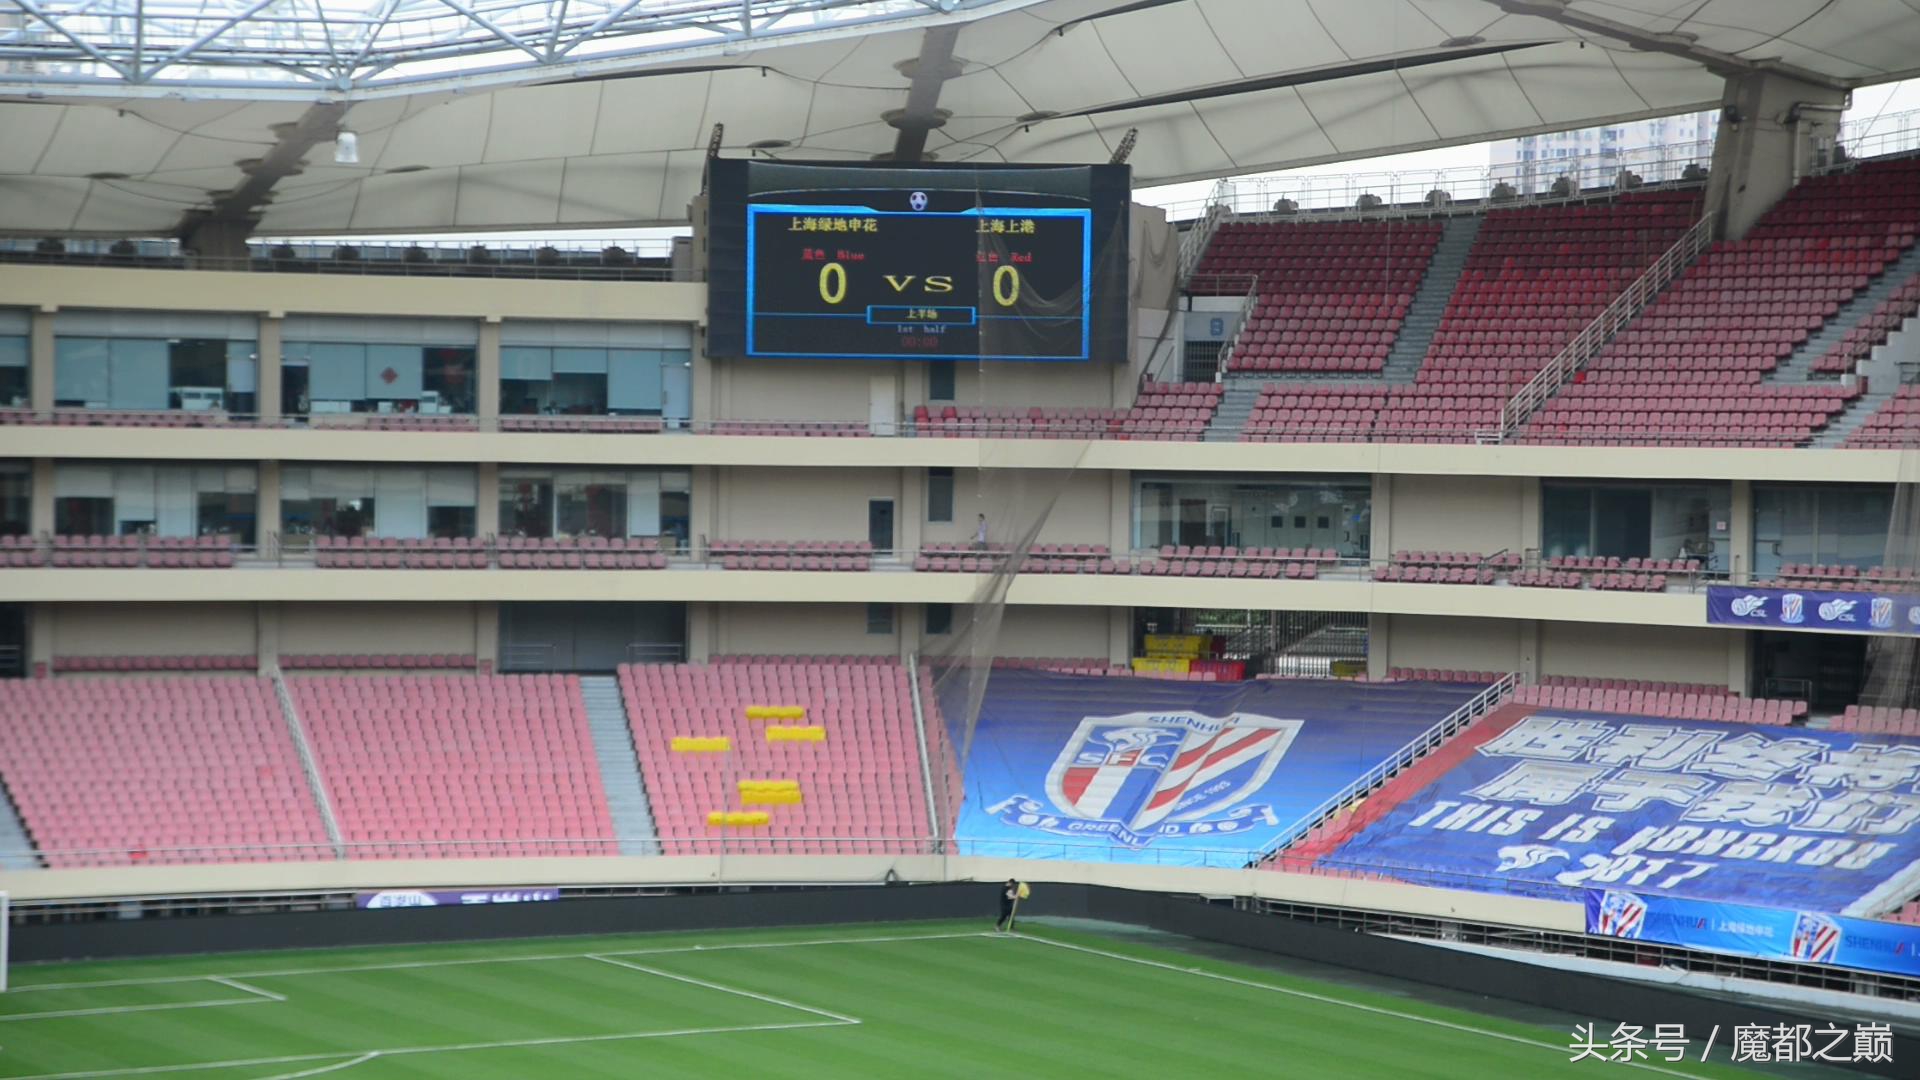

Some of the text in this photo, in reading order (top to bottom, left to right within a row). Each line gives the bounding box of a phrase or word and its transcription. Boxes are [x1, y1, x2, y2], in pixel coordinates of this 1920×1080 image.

[787, 216, 878, 232] 上海绿地申花
[976, 218, 1036, 234] 上海上港
[836, 249, 865, 261] Blue
[1010, 252, 1033, 263] Red
[818, 262, 848, 304] 0
[992, 265, 1021, 307] 0
[1750, 609, 1768, 618] CSL
[1838, 613, 1857, 622] CSL
[1076, 751, 1170, 769] SFC
[1408, 801, 1544, 836] THIS
[1537, 813, 1616, 843] IS
[1555, 853, 1719, 889] 2017
